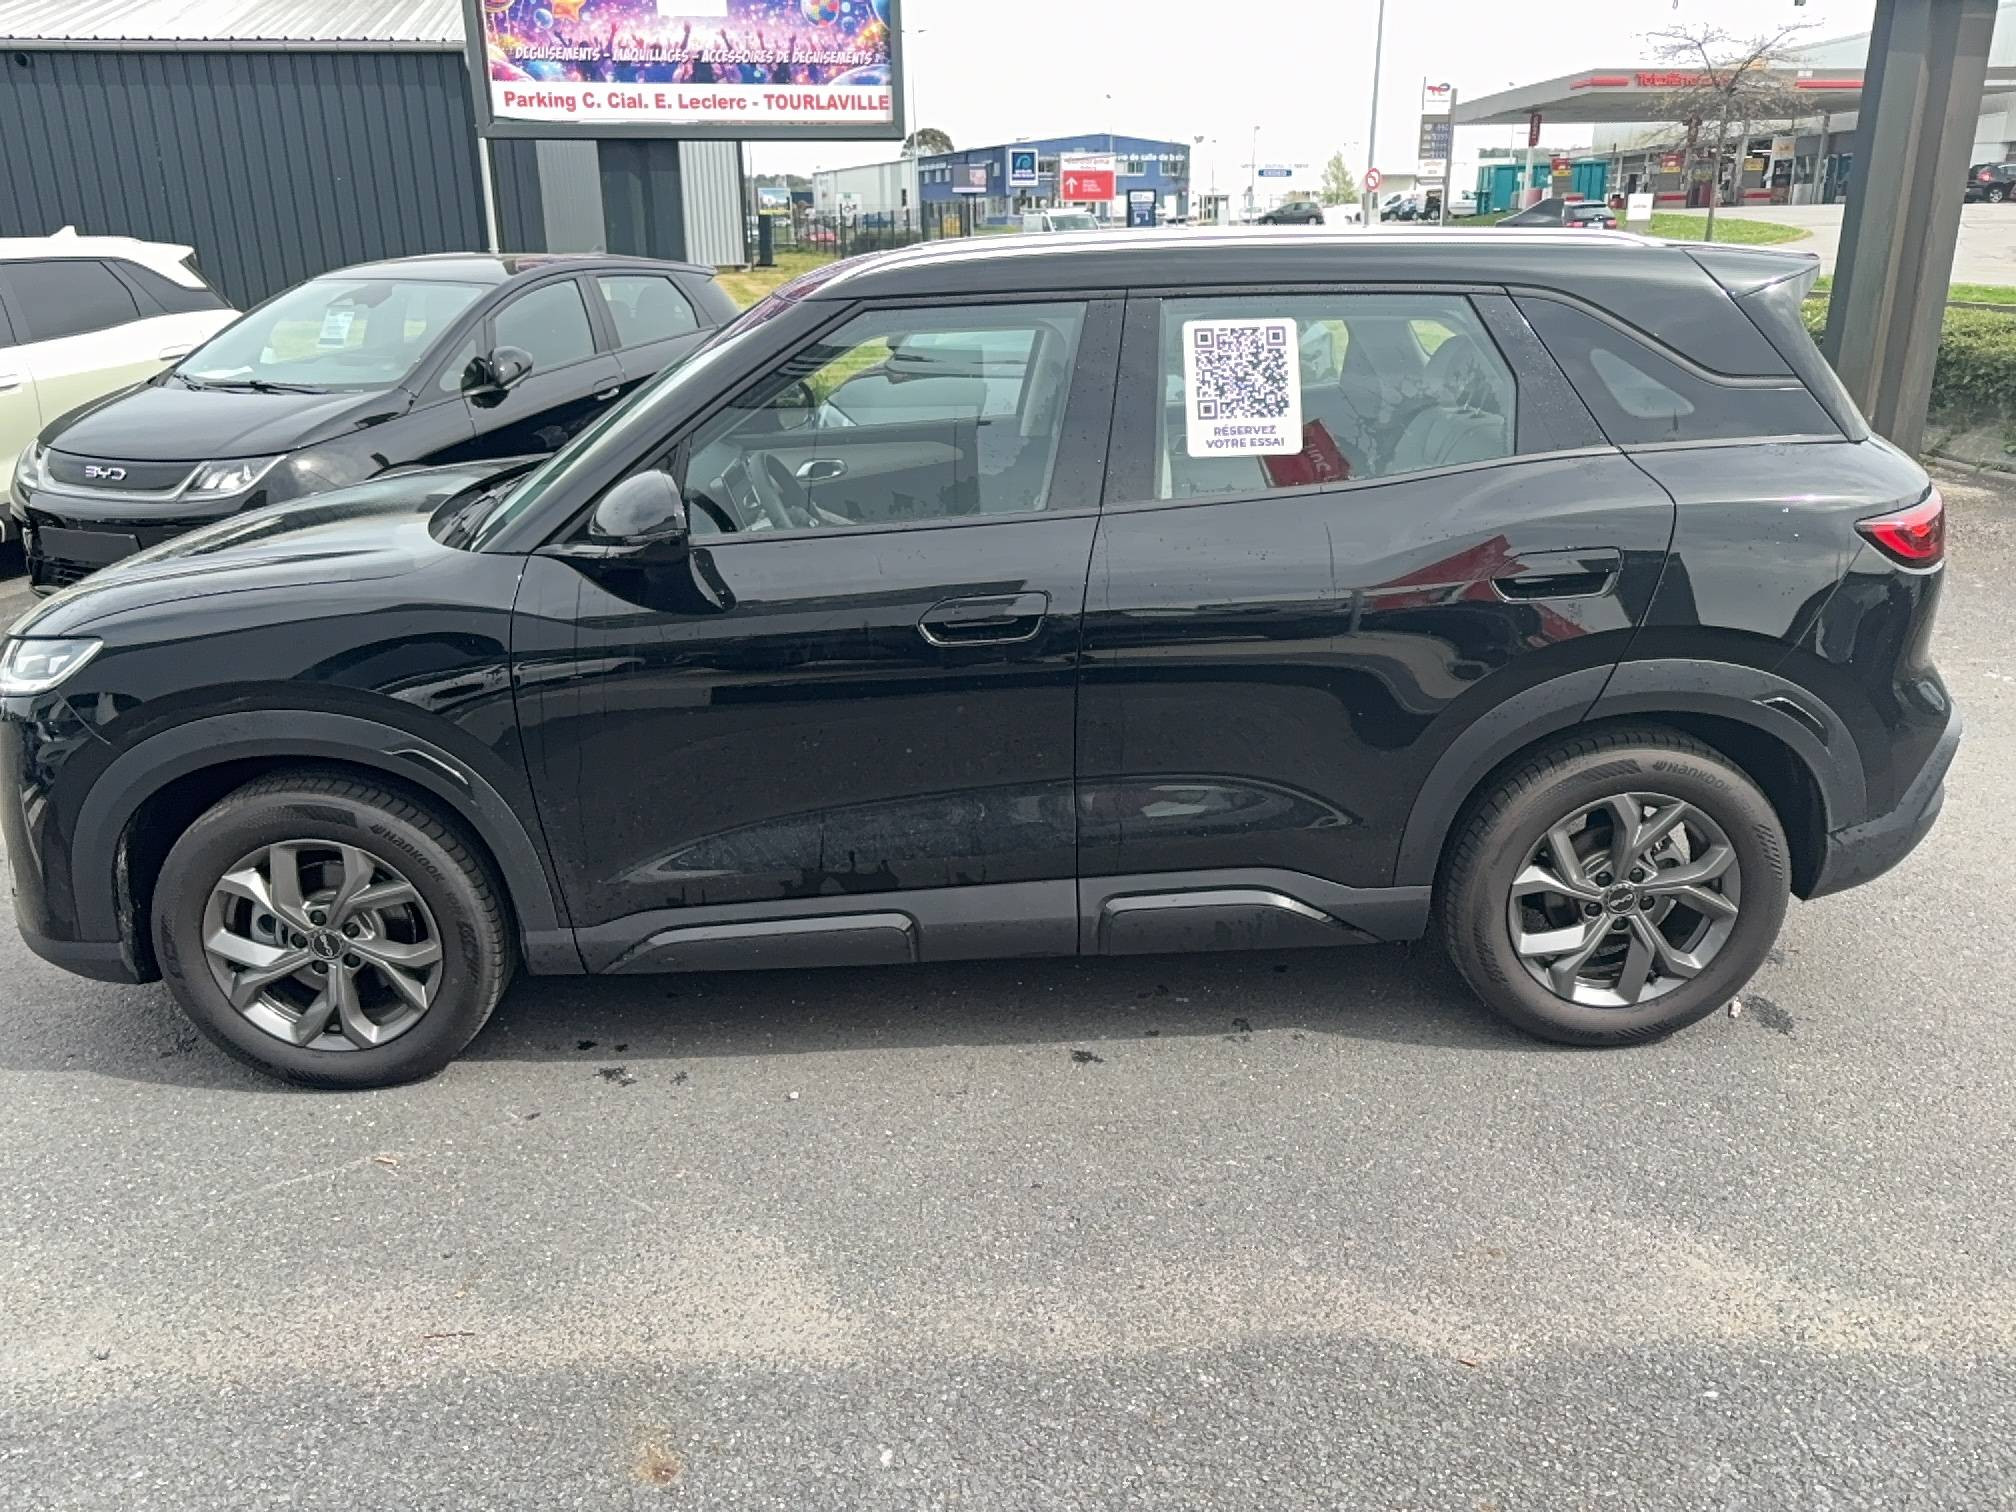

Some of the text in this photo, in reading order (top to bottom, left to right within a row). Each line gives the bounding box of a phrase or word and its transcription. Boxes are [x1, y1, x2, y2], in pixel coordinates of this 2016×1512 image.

[612, 48, 689, 62] MAQUILLAGES
[701, 50, 774, 64] ACCESSOIRES
[775, 50, 790, 63] DE
[503, 90, 576, 112] Parking
[582, 92, 601, 109] C.
[608, 92, 649, 109] Cial.
[655, 93, 672, 109] E.
[678, 93, 747, 110] Leclerc
[763, 94, 889, 110] TOURLAVILLE
[1213, 424, 1277, 437] RÉSERVEZ
[1206, 437, 1285, 449] VOTRE ESSAI
[85, 465, 127, 481] BYD
